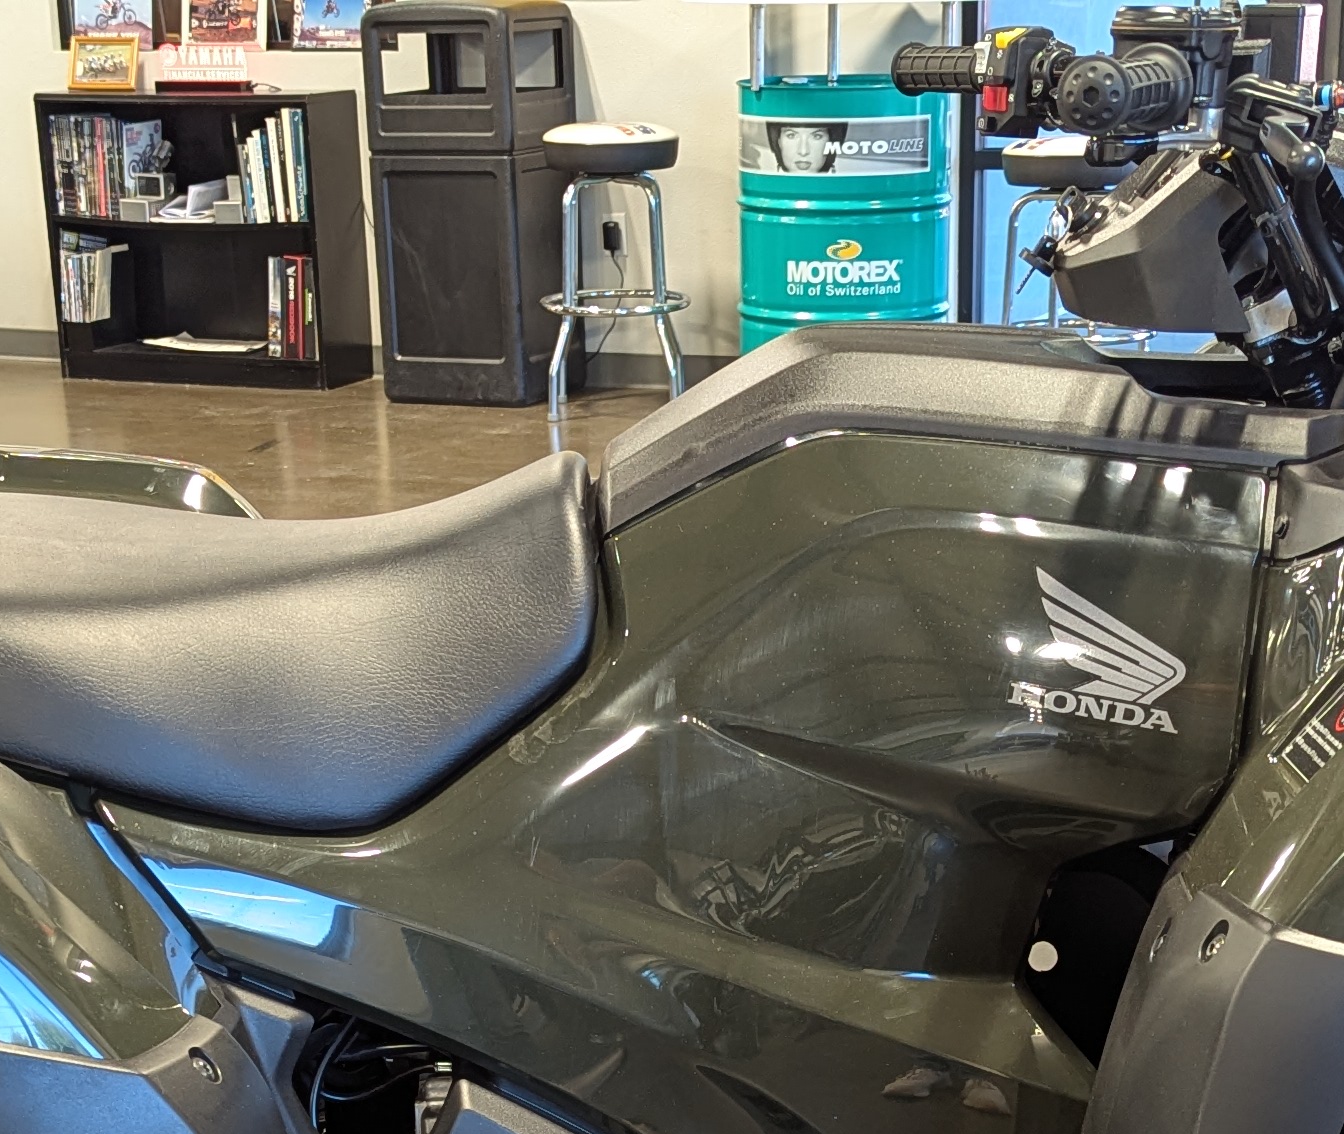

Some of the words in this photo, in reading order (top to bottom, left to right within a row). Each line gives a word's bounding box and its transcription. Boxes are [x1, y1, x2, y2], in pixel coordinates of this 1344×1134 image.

[177, 45, 245, 66] YAMAHA
[163, 70, 205, 81] FINANCIAL
[205, 70, 247, 81] SERVICES
[823, 138, 924, 155] MOTOLINE
[786, 259, 901, 284] MOTOREX
[787, 284, 804, 296] Oil
[808, 285, 822, 296] of
[825, 282, 902, 296] Switzerland
[1007, 681, 1178, 735] HONDA
